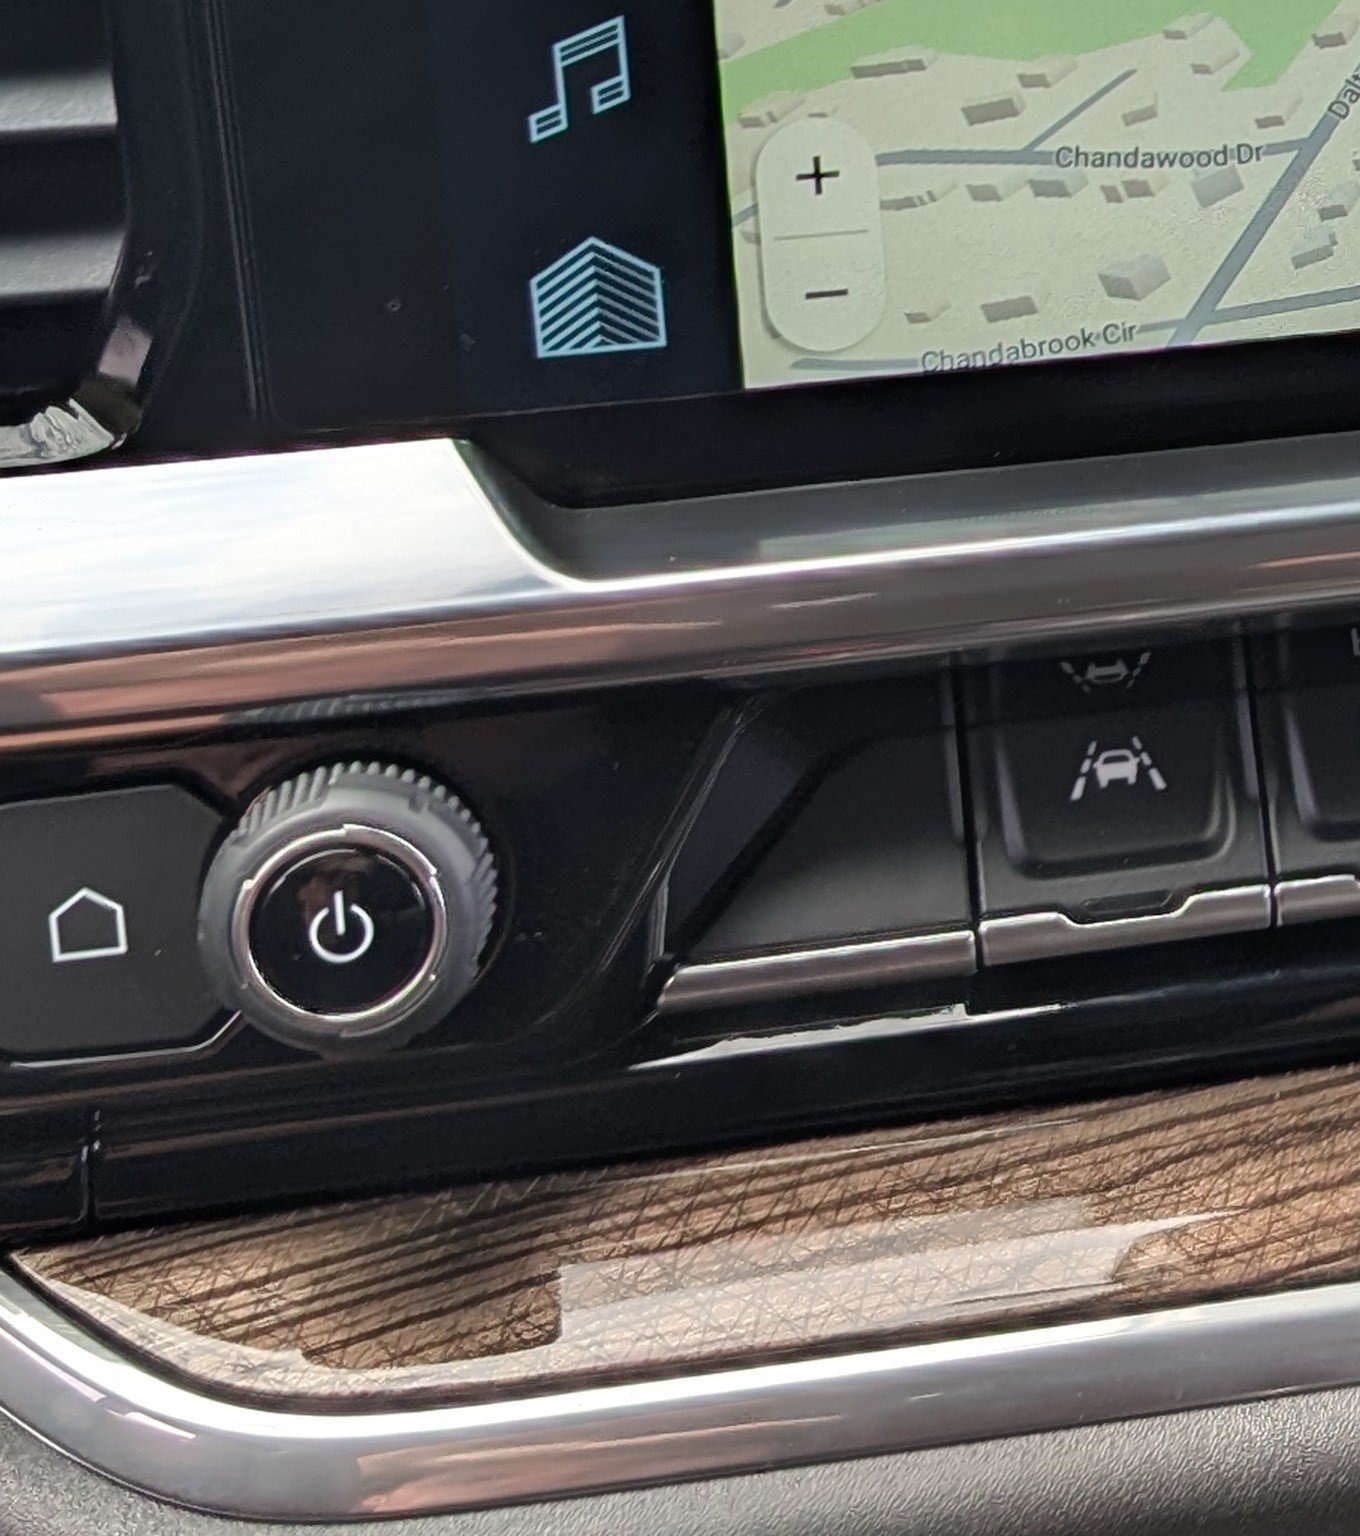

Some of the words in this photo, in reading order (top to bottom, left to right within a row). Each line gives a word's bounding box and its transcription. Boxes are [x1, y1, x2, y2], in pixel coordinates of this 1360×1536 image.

[1054, 144, 1229, 170] Chandawood
[1235, 140, 1263, 163] Dr
[921, 327, 1097, 375] Chandabrook
[1102, 321, 1137, 345] Cir
